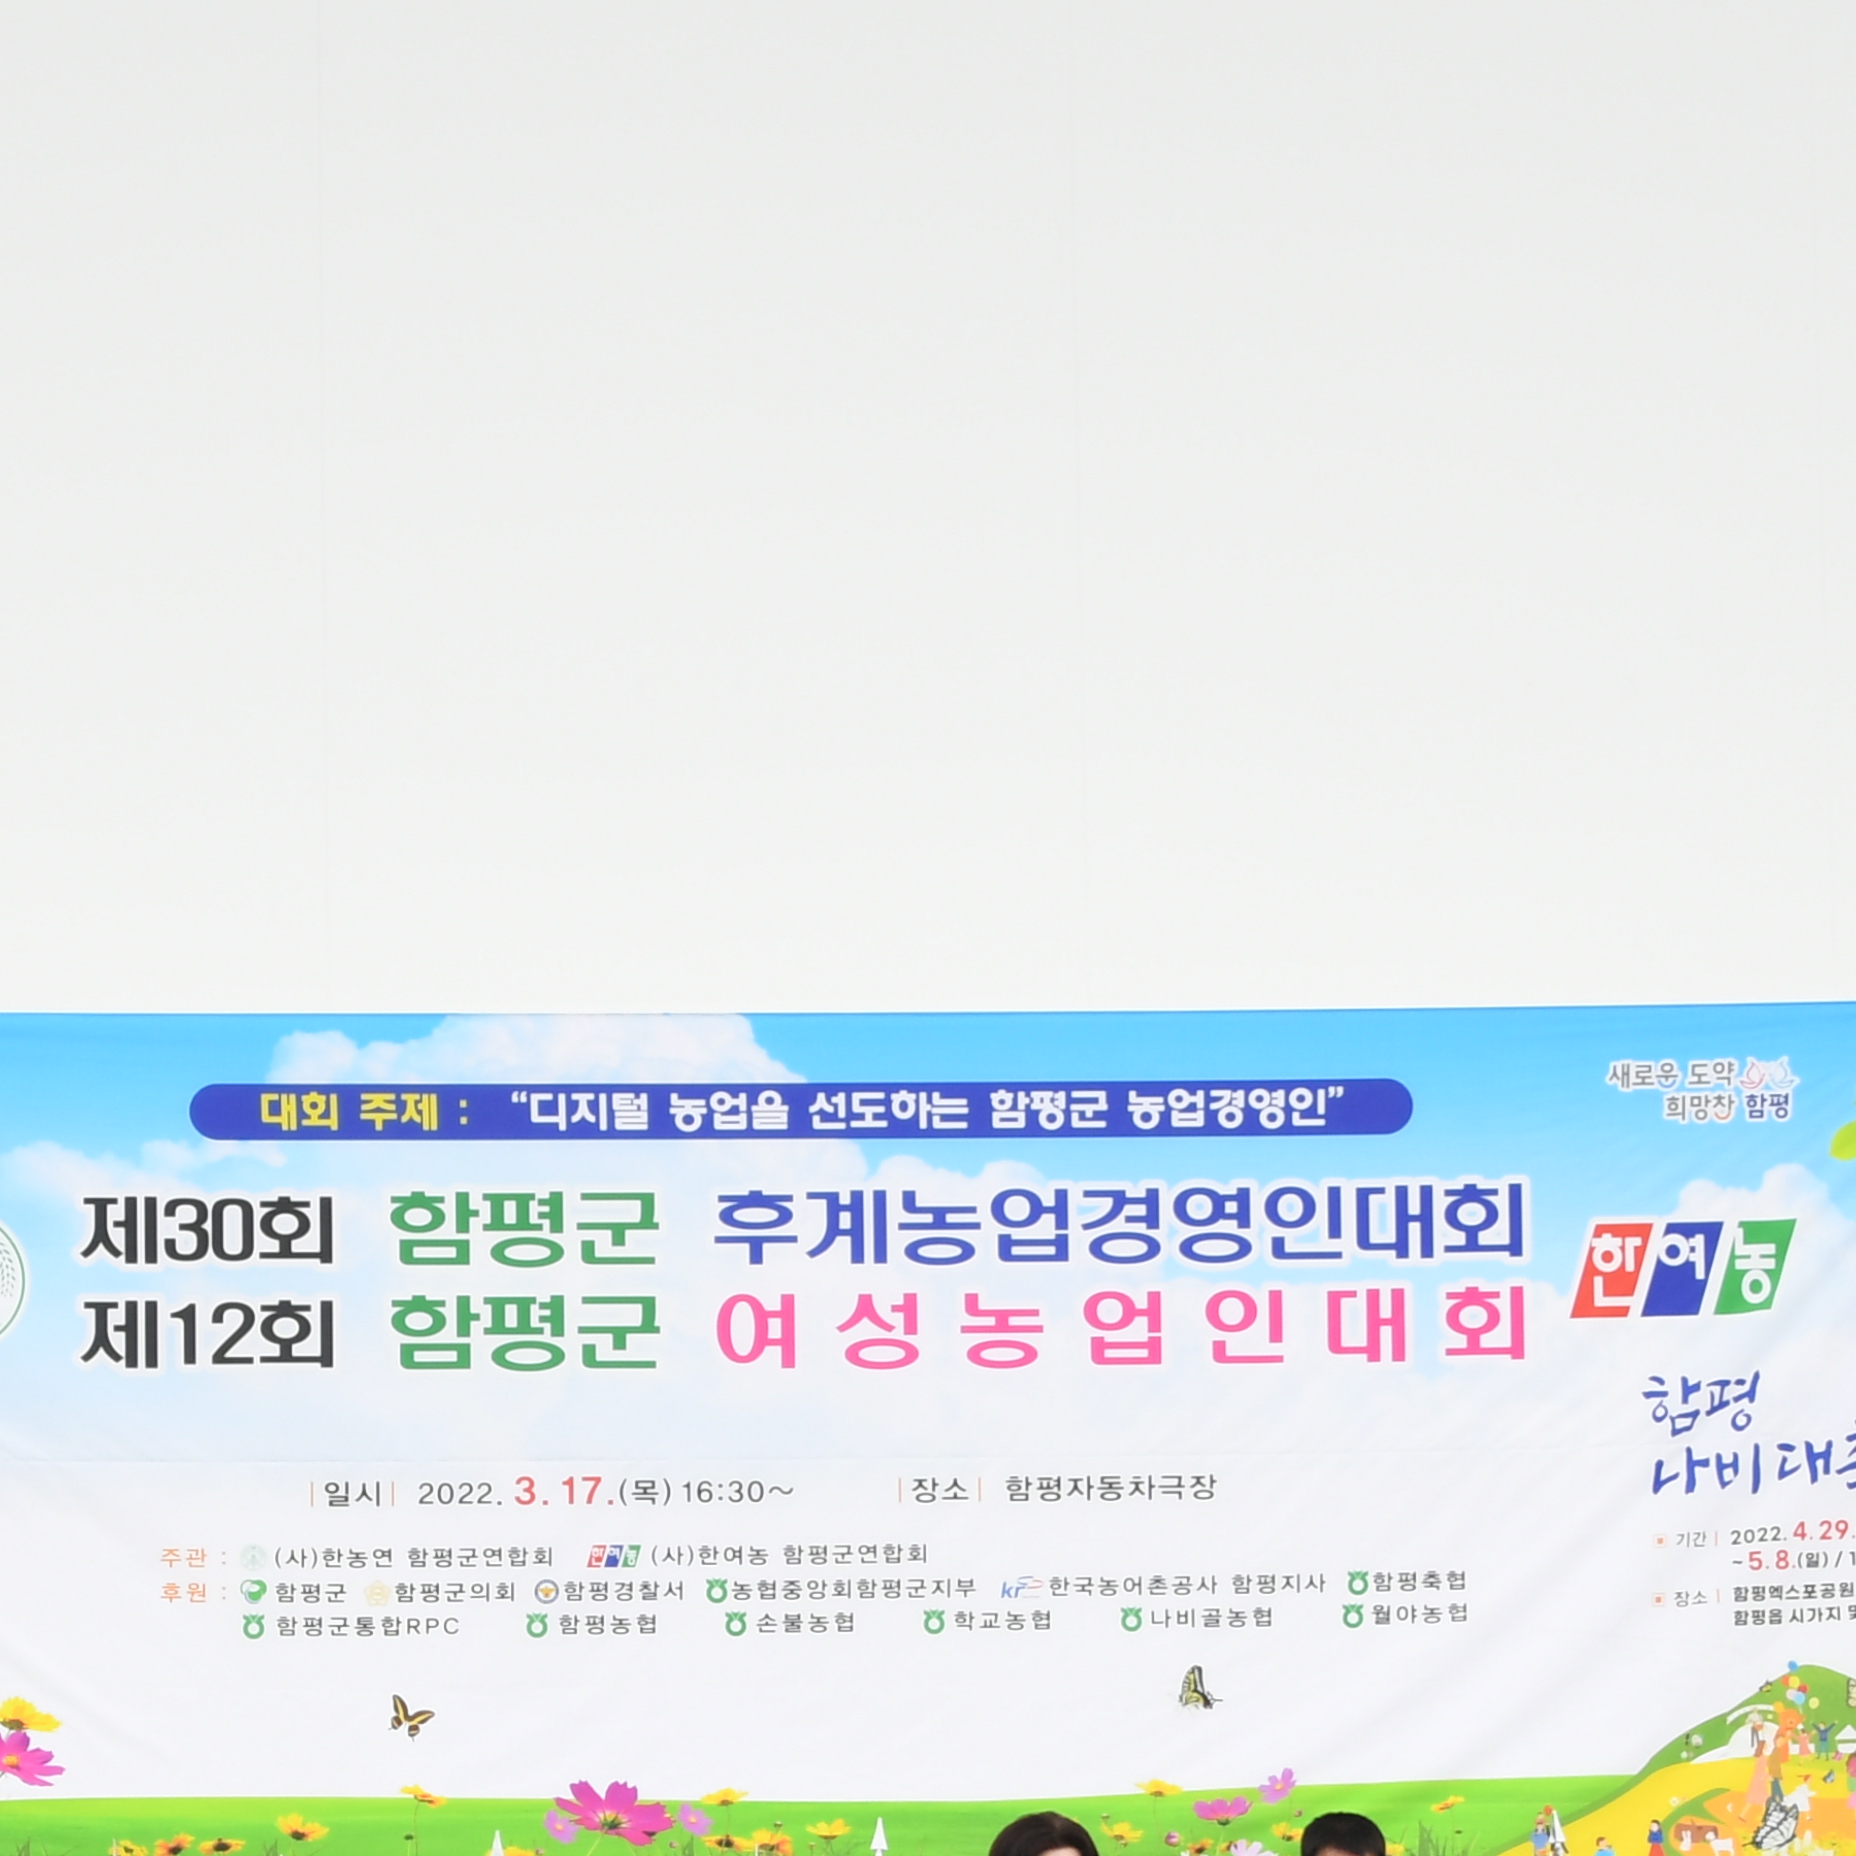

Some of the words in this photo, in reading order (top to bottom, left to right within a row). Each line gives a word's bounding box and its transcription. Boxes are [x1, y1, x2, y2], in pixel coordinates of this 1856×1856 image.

[1609, 1063, 1679, 1089] 새로운
[1688, 1062, 1734, 1087] 도약
[260, 1090, 338, 1132] 대회
[359, 1090, 438, 1132] 주제
[669, 1087, 788, 1131] 농업을
[808, 1088, 969, 1130] 선도하는
[990, 1086, 1109, 1130] 함평군
[1745, 1093, 1790, 1119] 함평
[79, 1195, 335, 1268] 제30회
[389, 1190, 663, 1269] 함평군
[714, 1183, 1526, 1266] 후계농업경영인대회
[1589, 1228, 1780, 1306] 한여농
[79, 1298, 335, 1372] 제12회
[389, 1293, 663, 1374] 함평군
[1642, 1370, 1761, 1437] 함평
[323, 1481, 383, 1507] 일시
[418, 1483, 502, 1506] 2022.
[911, 1477, 970, 1503] 장소
[1005, 1474, 1217, 1503] 함평자동차극장
[1676, 1531, 1707, 1548] 기간
[160, 1547, 208, 1568] 주관
[274, 1546, 395, 1569] (사)한농연
[407, 1546, 554, 1568] 함평군연합회
[651, 1545, 769, 1566] (사)한여농
[783, 1544, 928, 1566] 함평군연합회
[160, 1583, 208, 1603] 후원
[275, 1582, 348, 1603] 함평군
[394, 1581, 516, 1603] 함평군의회
[563, 1580, 686, 1602] 함평경찰서
[731, 1577, 977, 1600] 농협중앙회함평군지부
[1048, 1576, 1219, 1598] 한국농어촌공사
[1231, 1574, 1327, 1595] 함평지사
[1372, 1571, 1468, 1593] 함평축협
[1673, 1590, 1709, 1607] 장소
[275, 1616, 461, 1638] 함평군통합RPC
[557, 1615, 658, 1636] 함평농협
[756, 1613, 856, 1634] 손불농협
[953, 1610, 1052, 1632] 학교농협
[1151, 1607, 1273, 1629] 나비골농협
[1371, 1603, 1469, 1626] 월야농협
